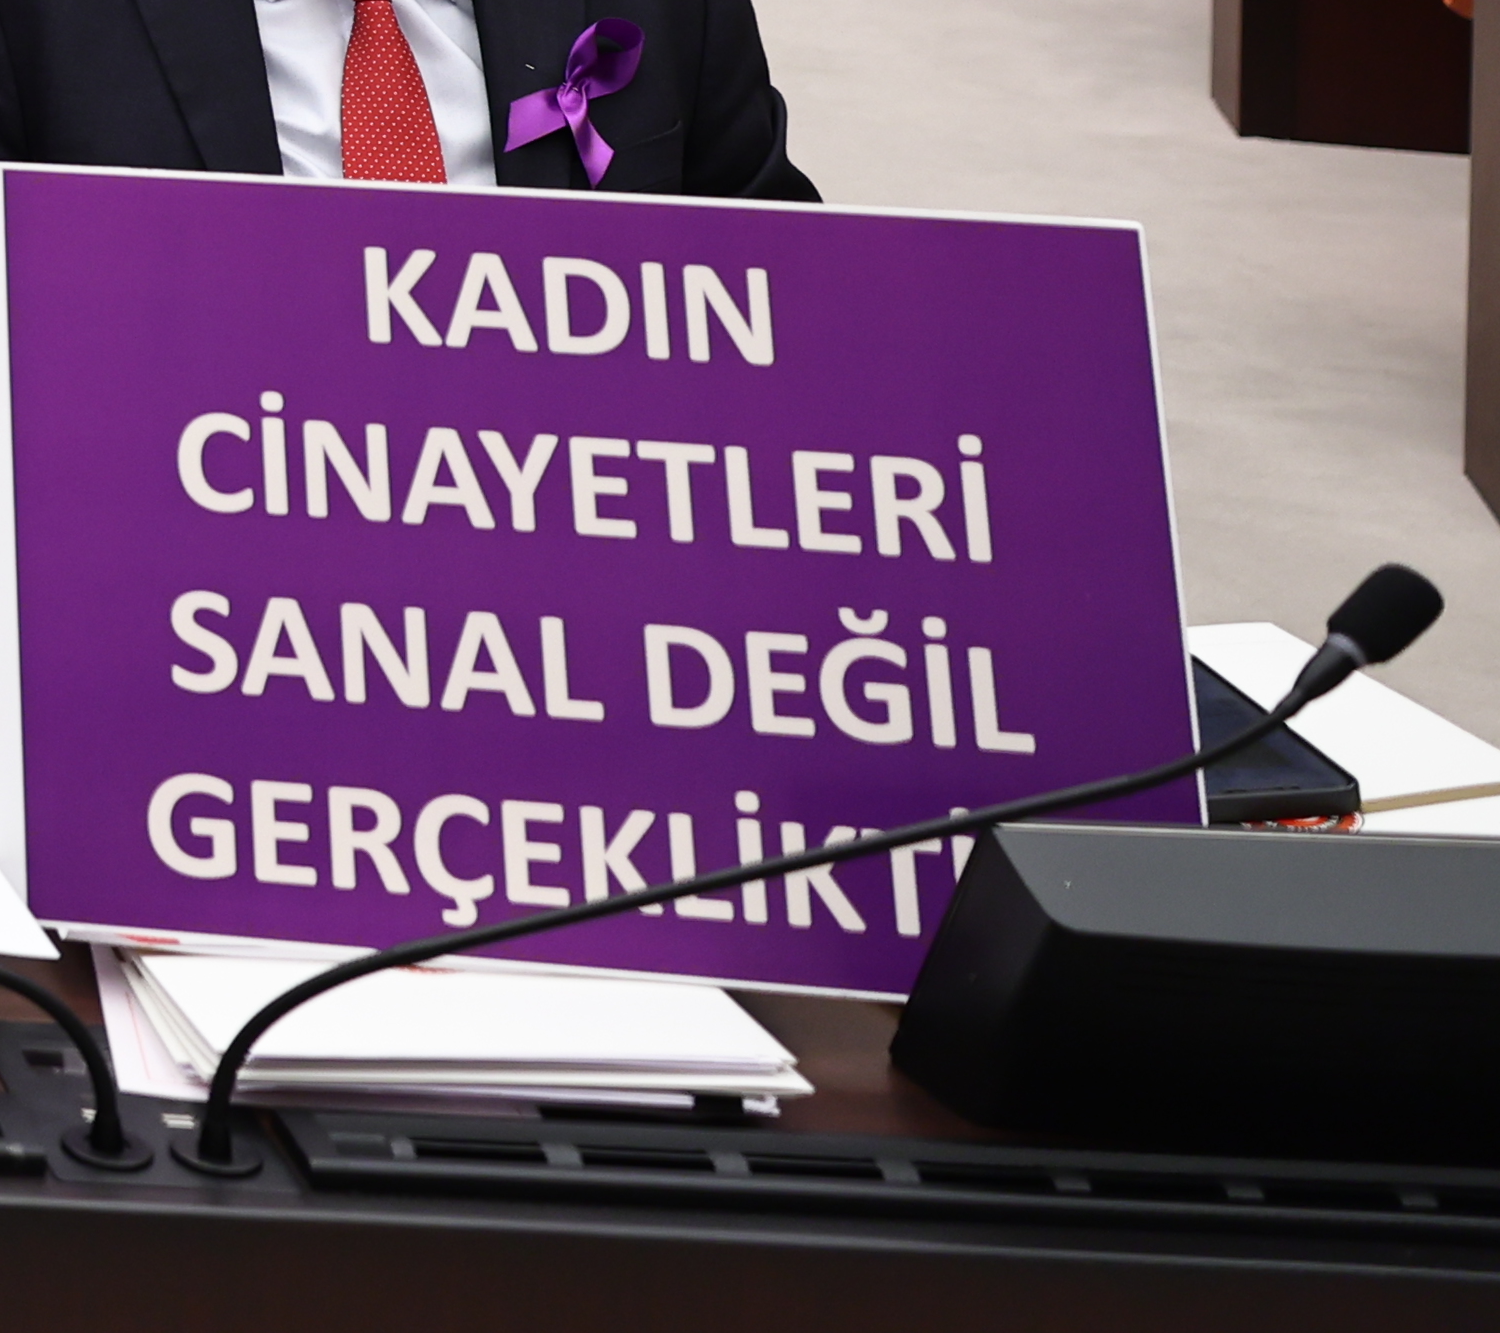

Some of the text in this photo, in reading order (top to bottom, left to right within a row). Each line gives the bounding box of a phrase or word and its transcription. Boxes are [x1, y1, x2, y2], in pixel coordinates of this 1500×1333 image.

[362, 245, 775, 366] KADIN
[175, 391, 994, 564] CİNAYETLERİ
[168, 590, 1037, 755] SANAL DEĞİL
[145, 772, 975, 938] GERÇEKLİKT
